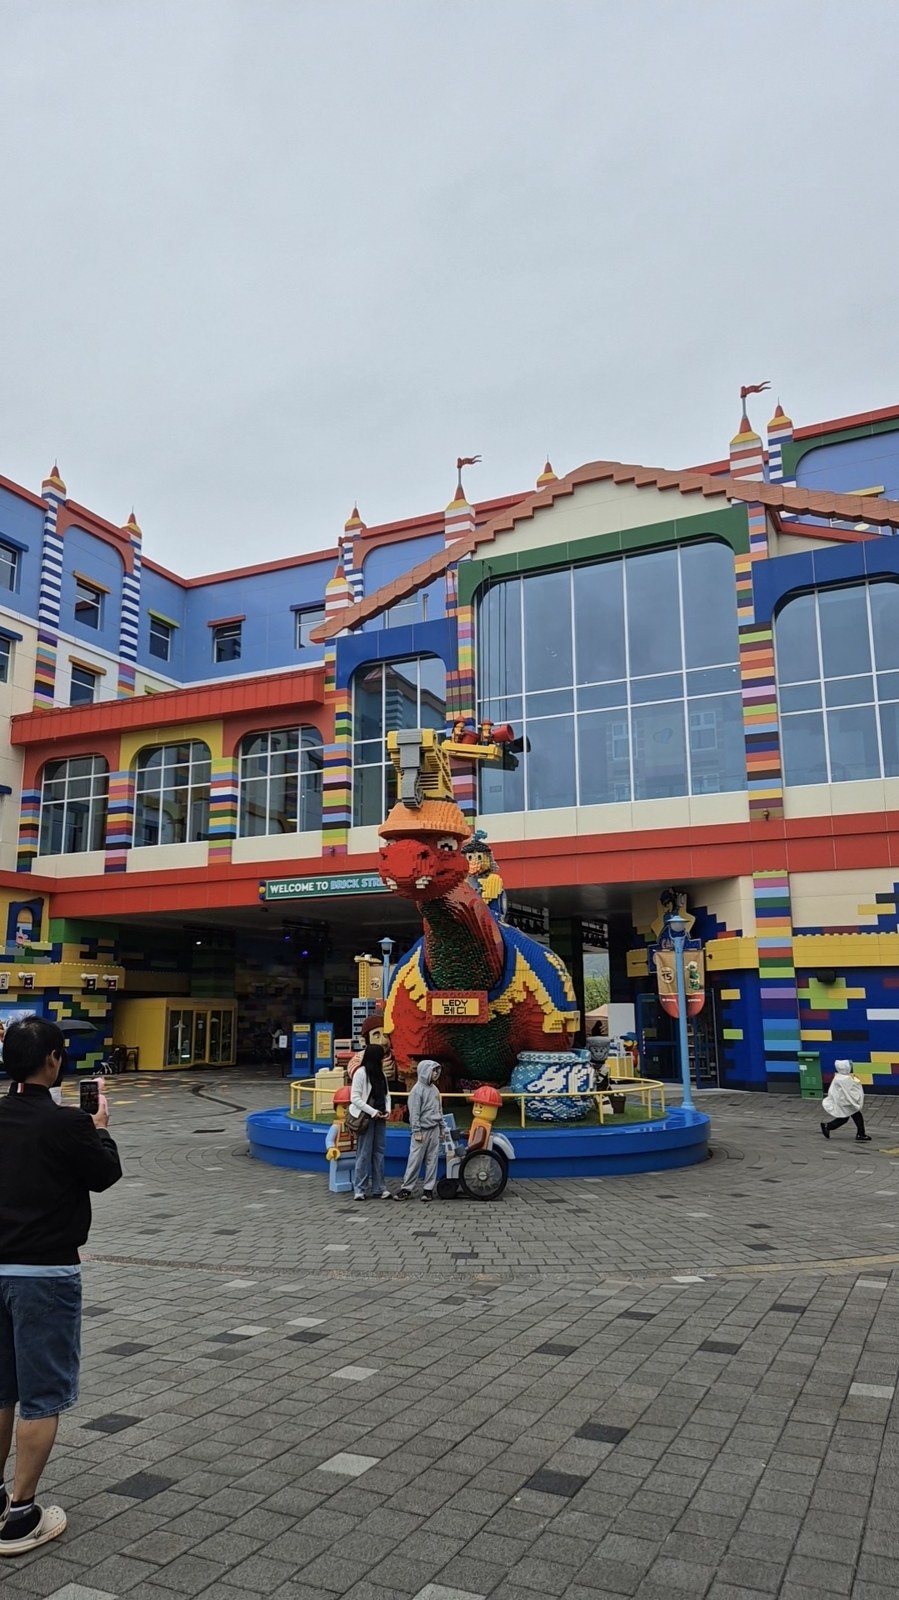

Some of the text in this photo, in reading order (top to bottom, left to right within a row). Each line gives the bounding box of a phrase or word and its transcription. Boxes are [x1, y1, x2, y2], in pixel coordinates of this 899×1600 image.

[270, 882, 315, 894] WELCOME
[316, 881, 329, 891] TO
[330, 879, 360, 890] BRICK
[662, 972, 673, 981] 15
[442, 999, 468, 1007] LEDY
[444, 1006, 467, 1015] 레디
